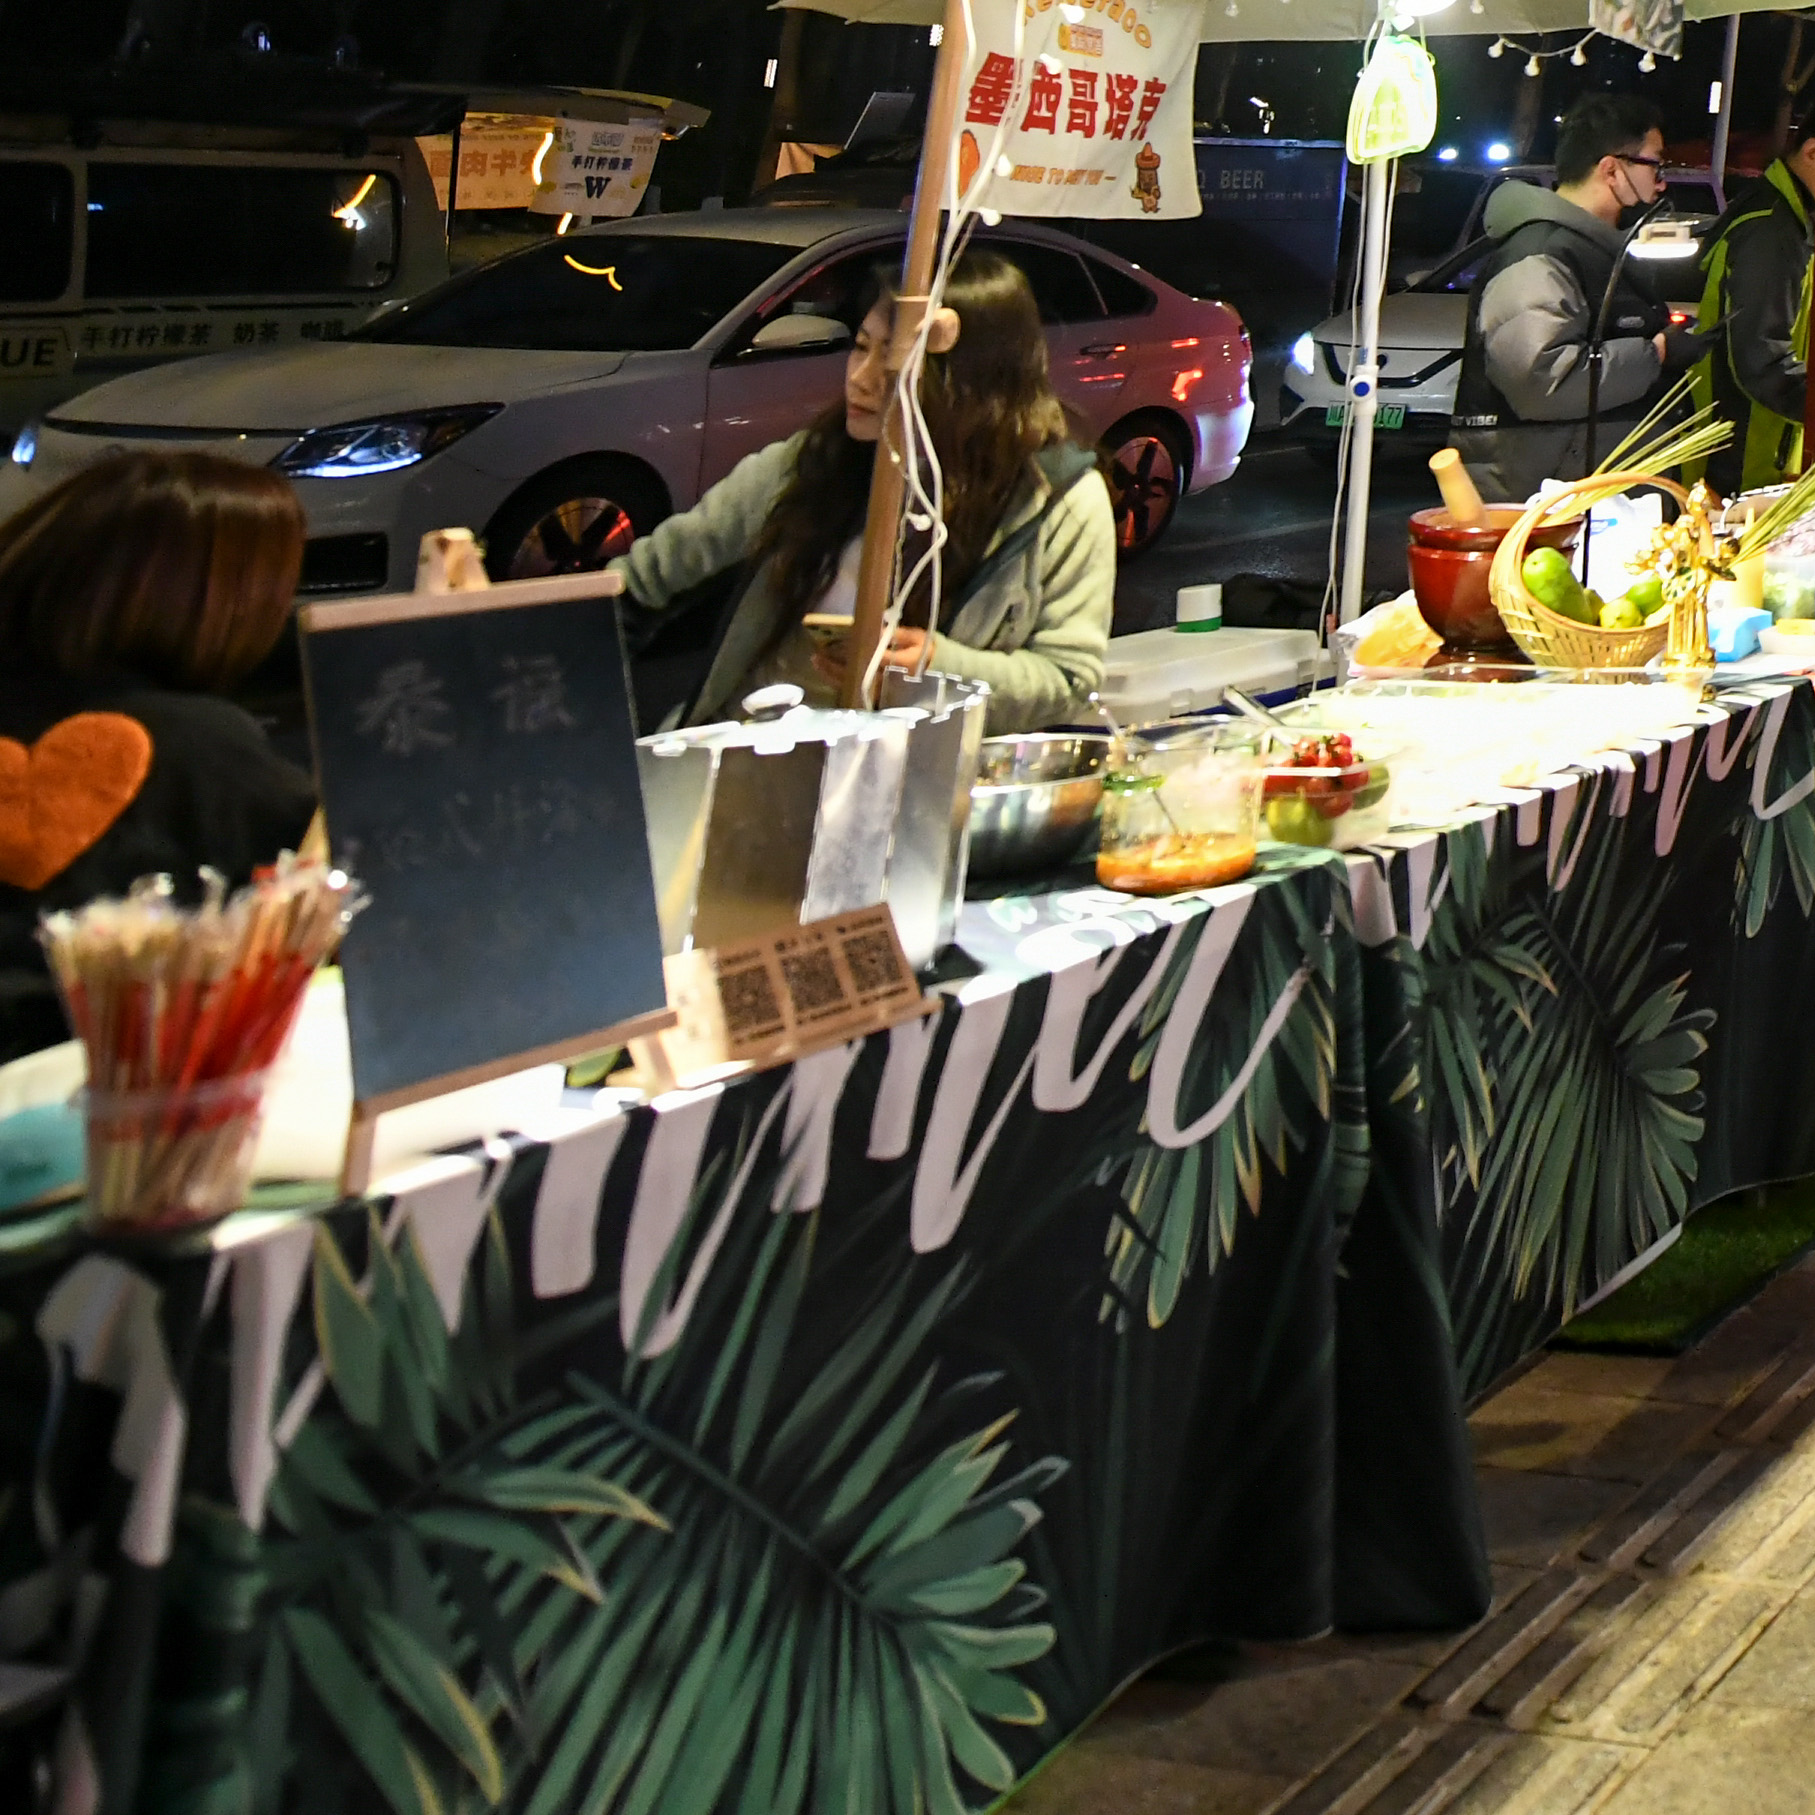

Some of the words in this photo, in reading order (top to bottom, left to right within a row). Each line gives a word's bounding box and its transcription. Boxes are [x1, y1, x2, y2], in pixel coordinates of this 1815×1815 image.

[965, 51, 1168, 141] 墨西哥塔克
[1220, 169, 1265, 190] BEER
